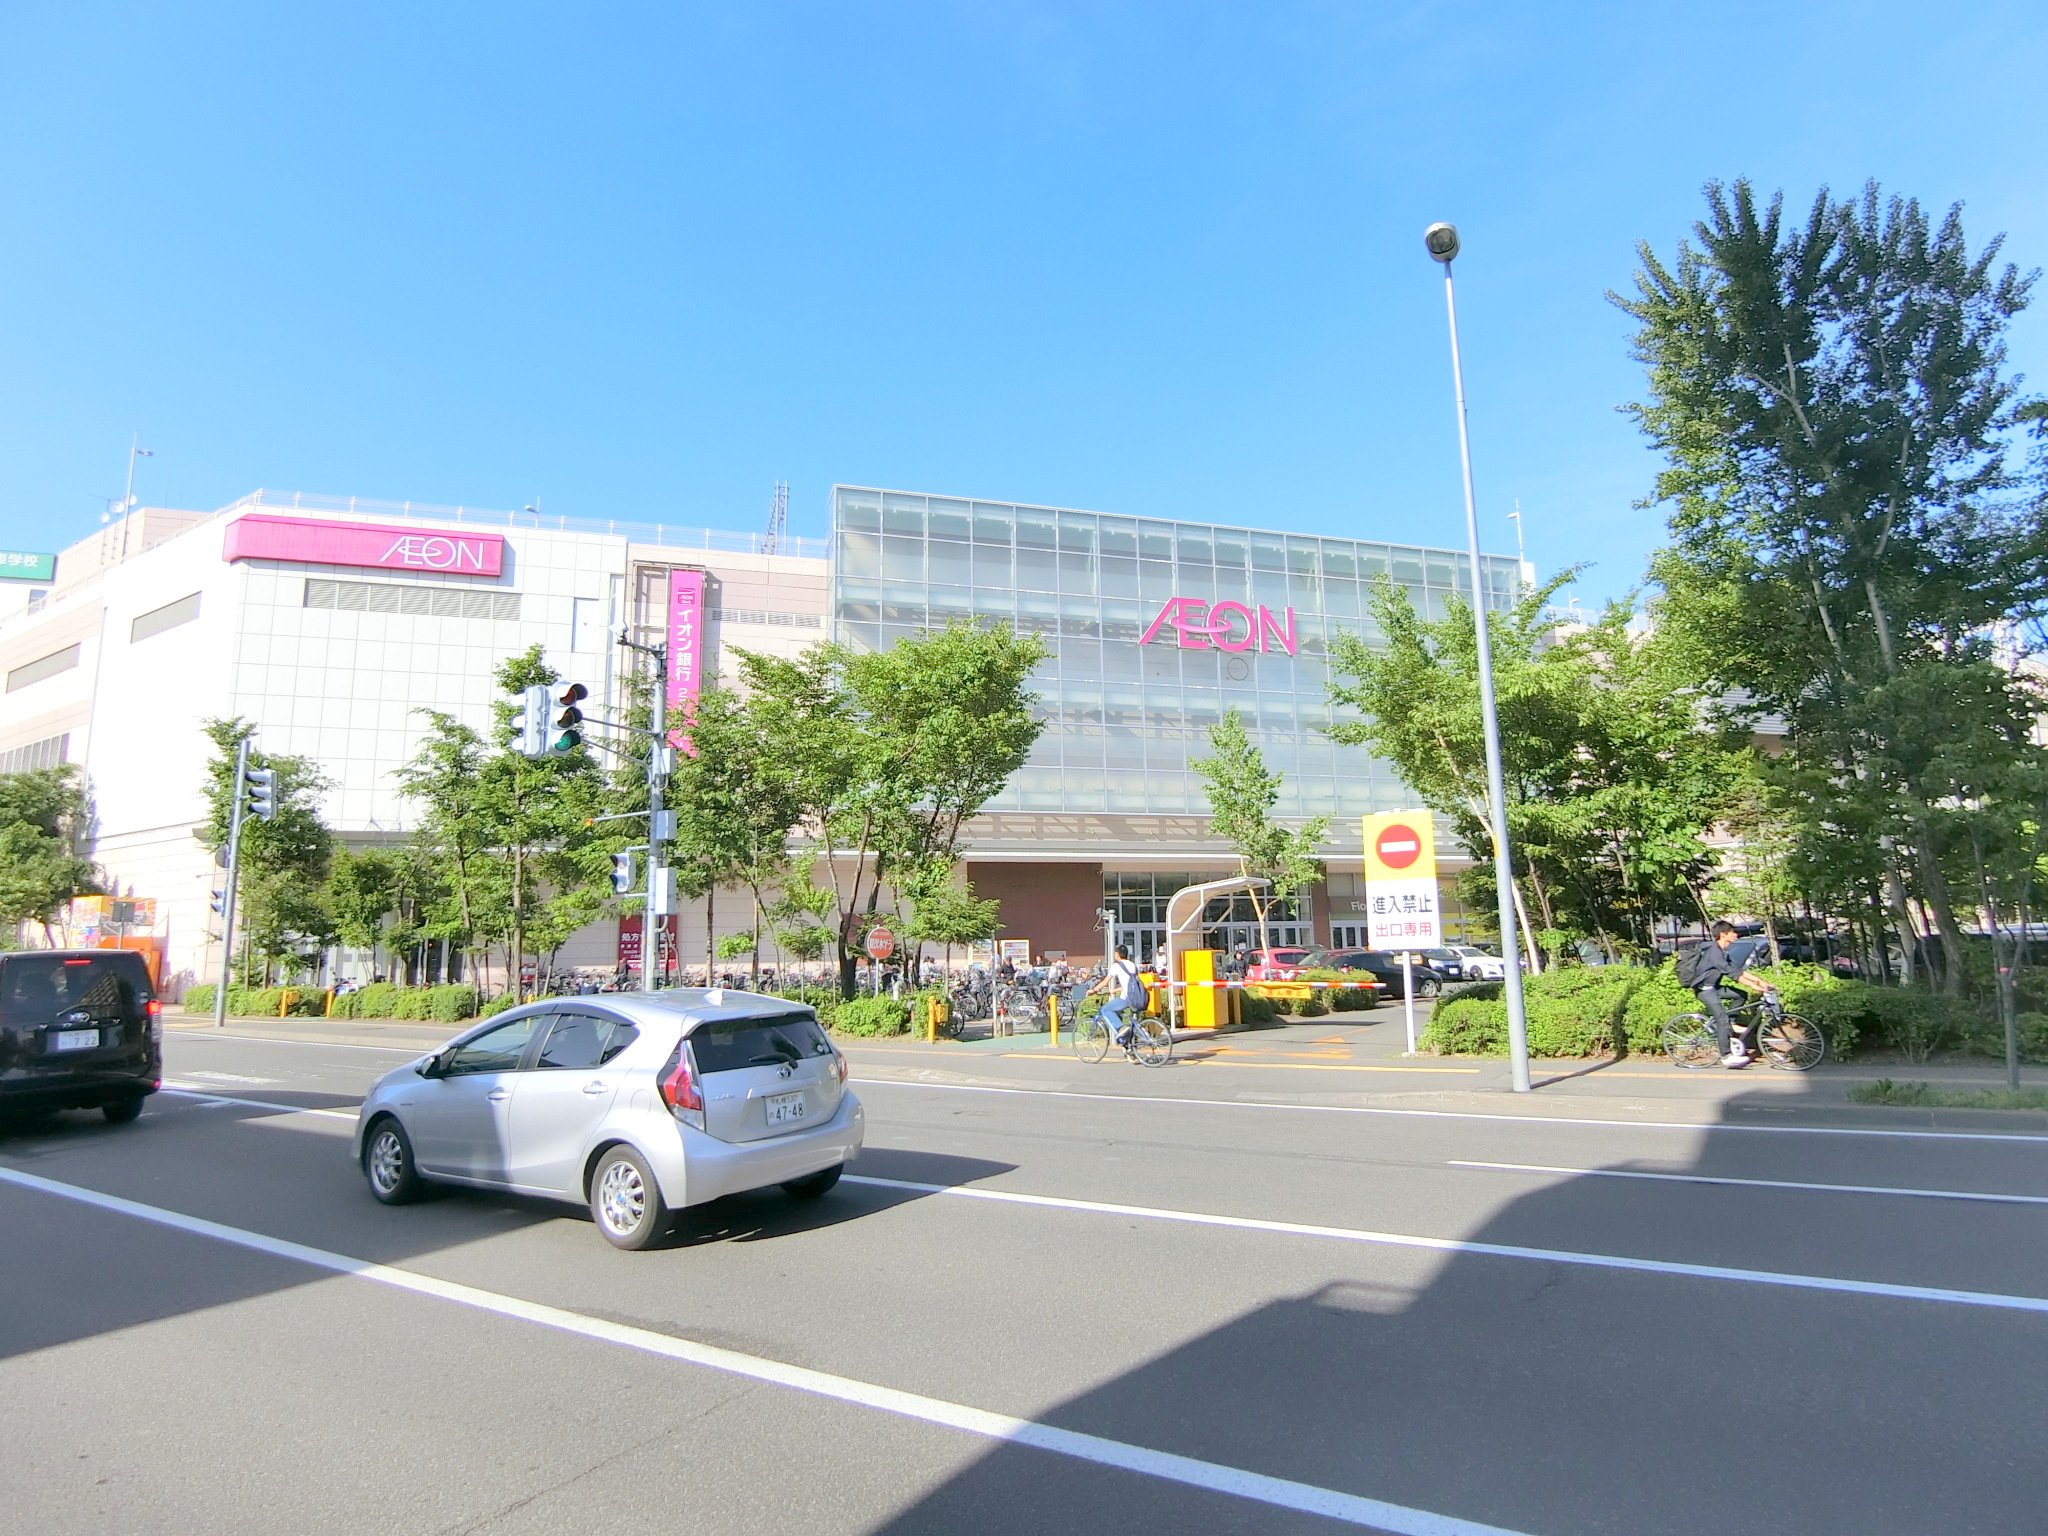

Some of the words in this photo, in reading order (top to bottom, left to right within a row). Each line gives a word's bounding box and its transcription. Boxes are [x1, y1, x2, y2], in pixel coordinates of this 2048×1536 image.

[676, 609, 693, 682] イオン銀行
[1372, 894, 1433, 915] 進入禁止
[1376, 922, 1432, 937] 出口専用
[776, 1103, 804, 1121] 47-48
